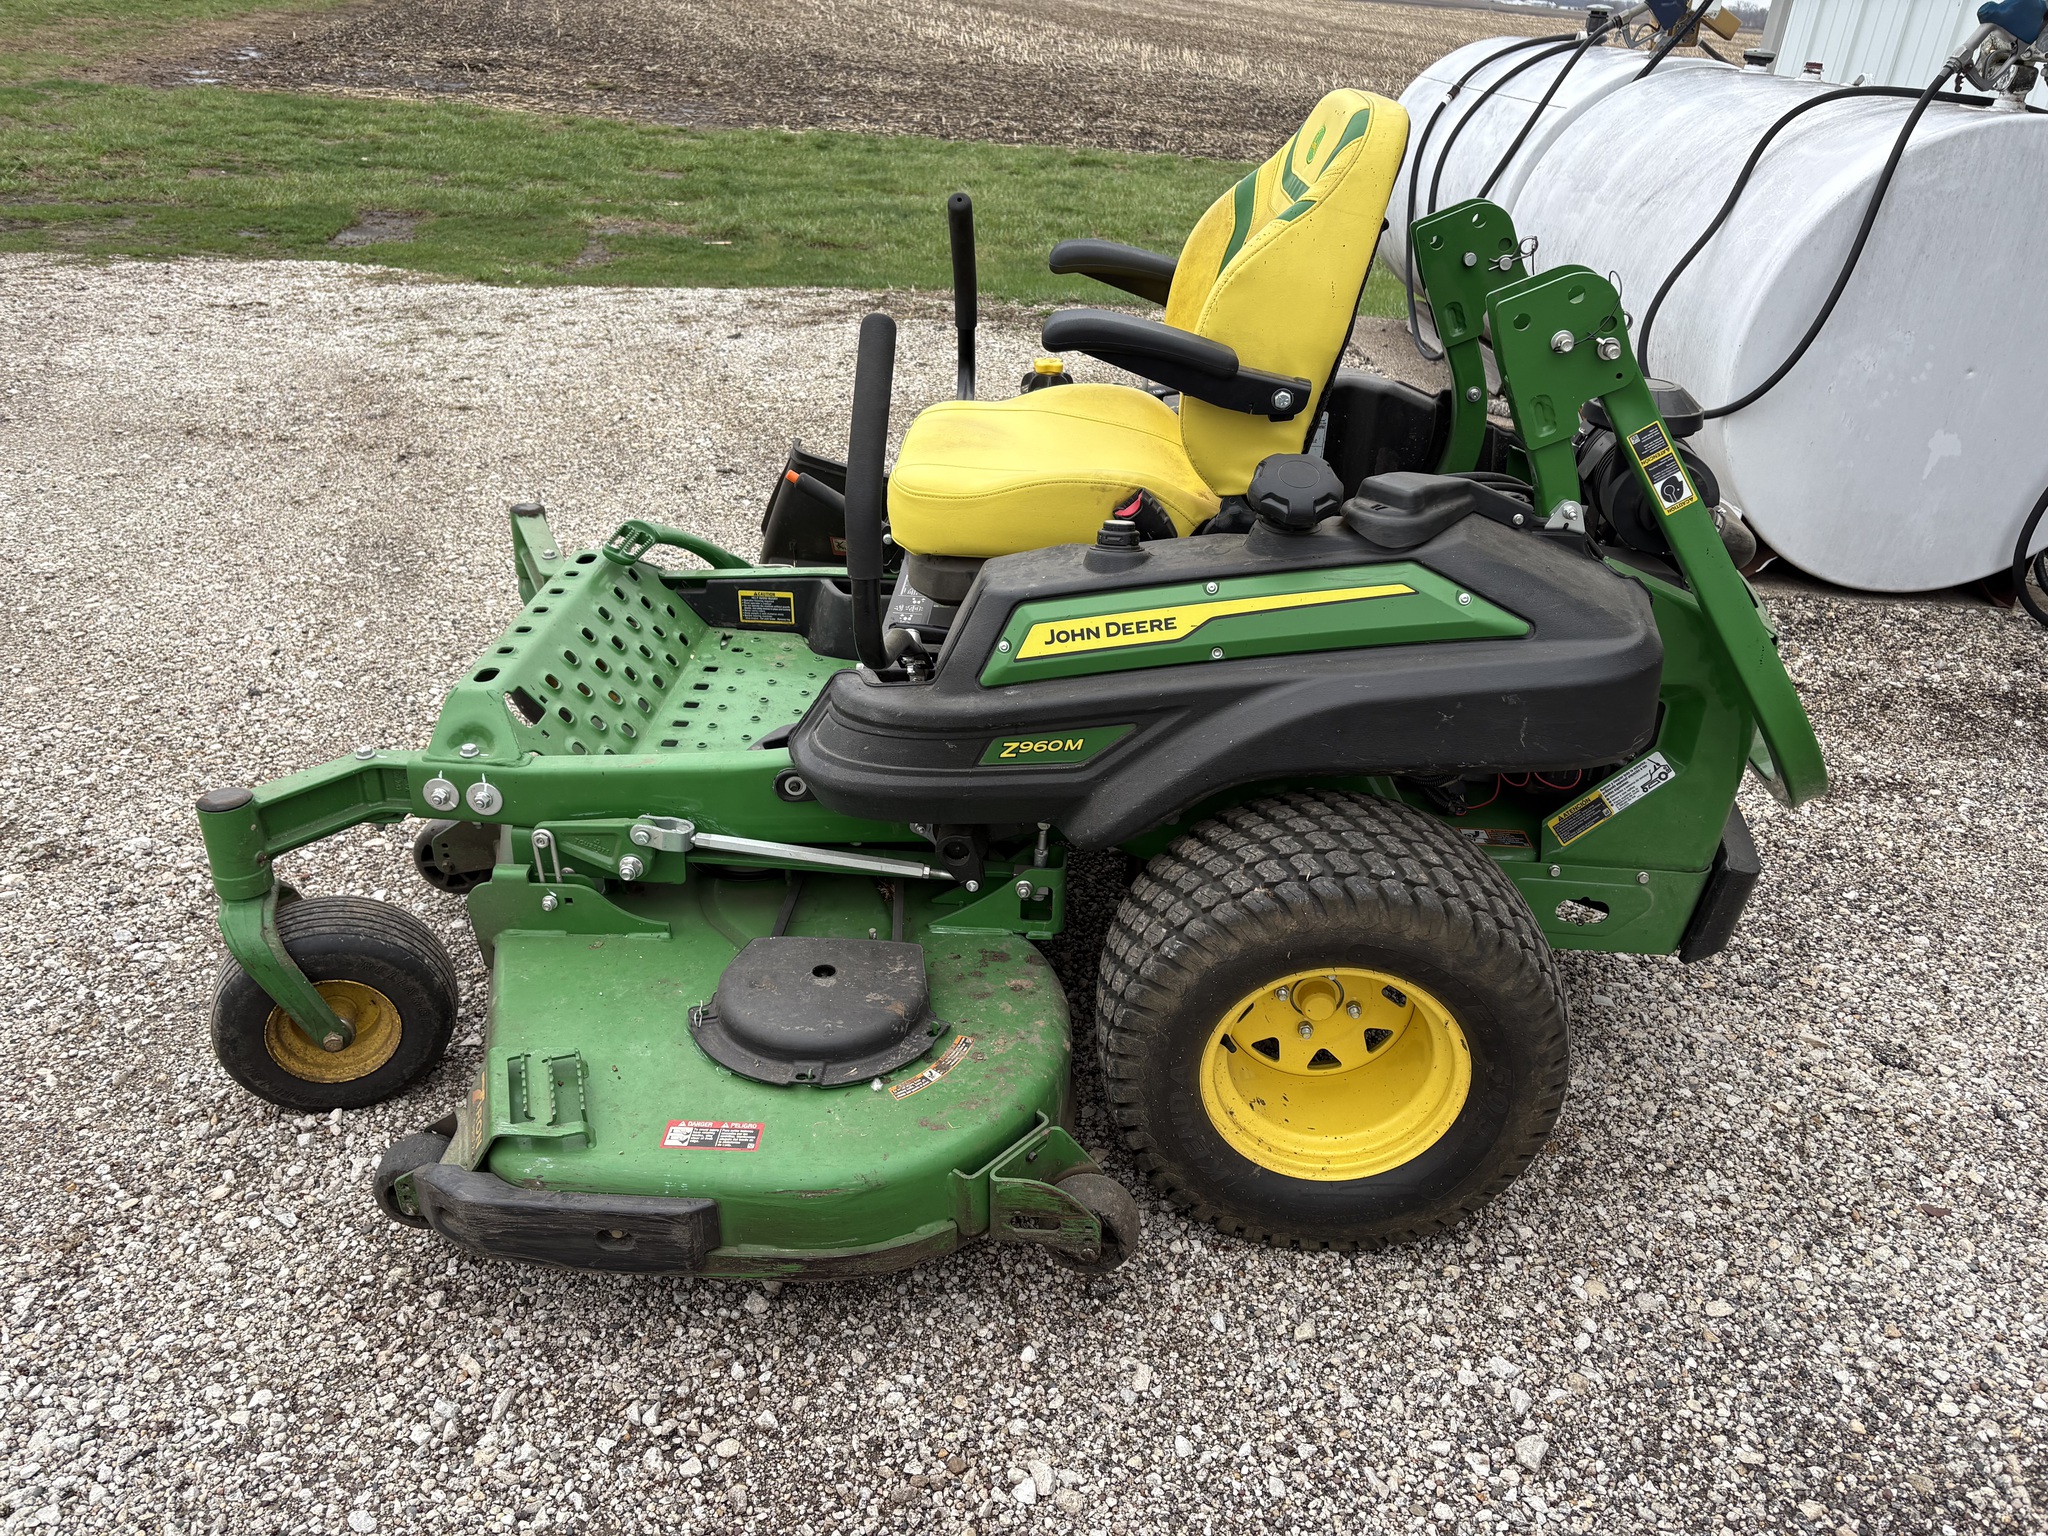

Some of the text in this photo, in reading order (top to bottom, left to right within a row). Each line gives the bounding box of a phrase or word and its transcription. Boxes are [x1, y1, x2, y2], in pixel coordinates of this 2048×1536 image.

[1667, 499, 1691, 514] CAUTION
[1044, 616, 1178, 646] JOHN DEERE
[999, 738, 1085, 759] Z960M
[1563, 796, 1591, 818] ATENCIÓN
[1168, 1063, 1232, 1184] KENDA
